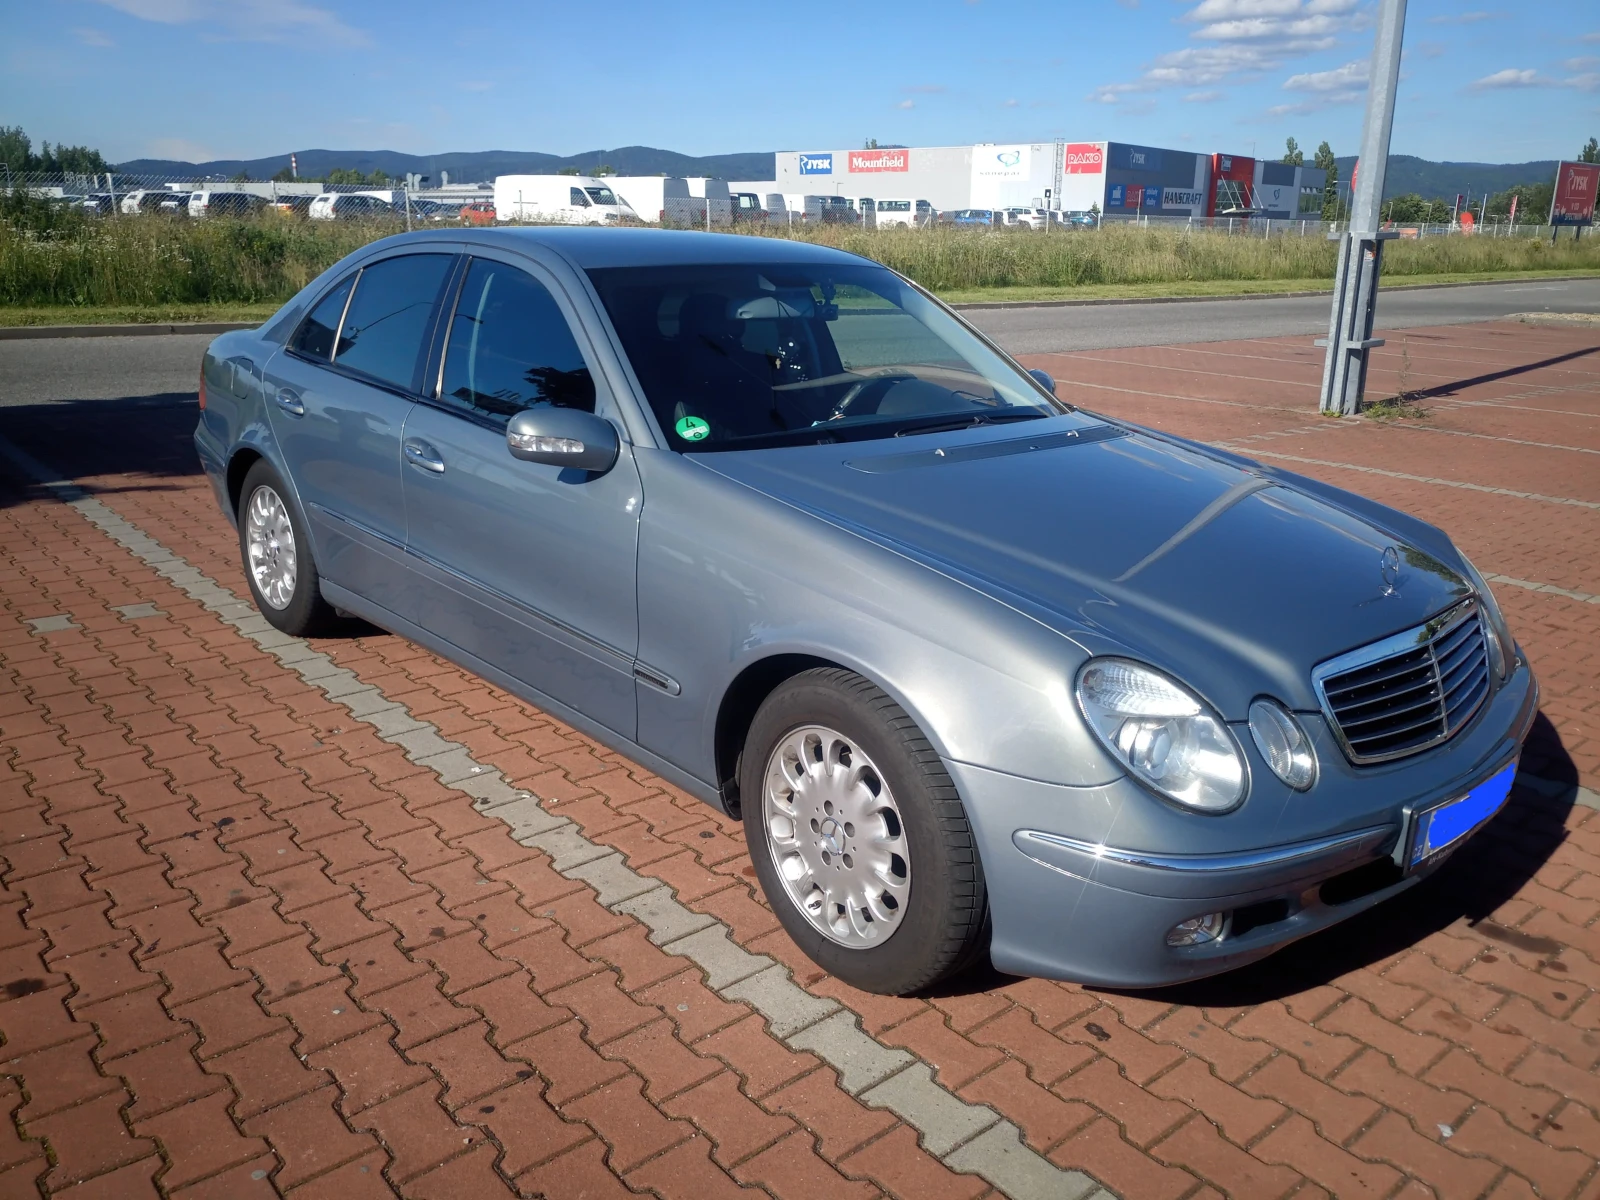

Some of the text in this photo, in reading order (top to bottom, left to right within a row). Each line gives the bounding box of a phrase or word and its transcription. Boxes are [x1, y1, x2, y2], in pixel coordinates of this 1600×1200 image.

[806, 159, 831, 170] JYSK
[852, 156, 904, 169] Mountfield
[1067, 152, 1102, 165] RAKO
[1133, 152, 1146, 165] JYSK
[1572, 176, 1588, 190] JYSK
[1164, 192, 1203, 205] HANSCRAFT
